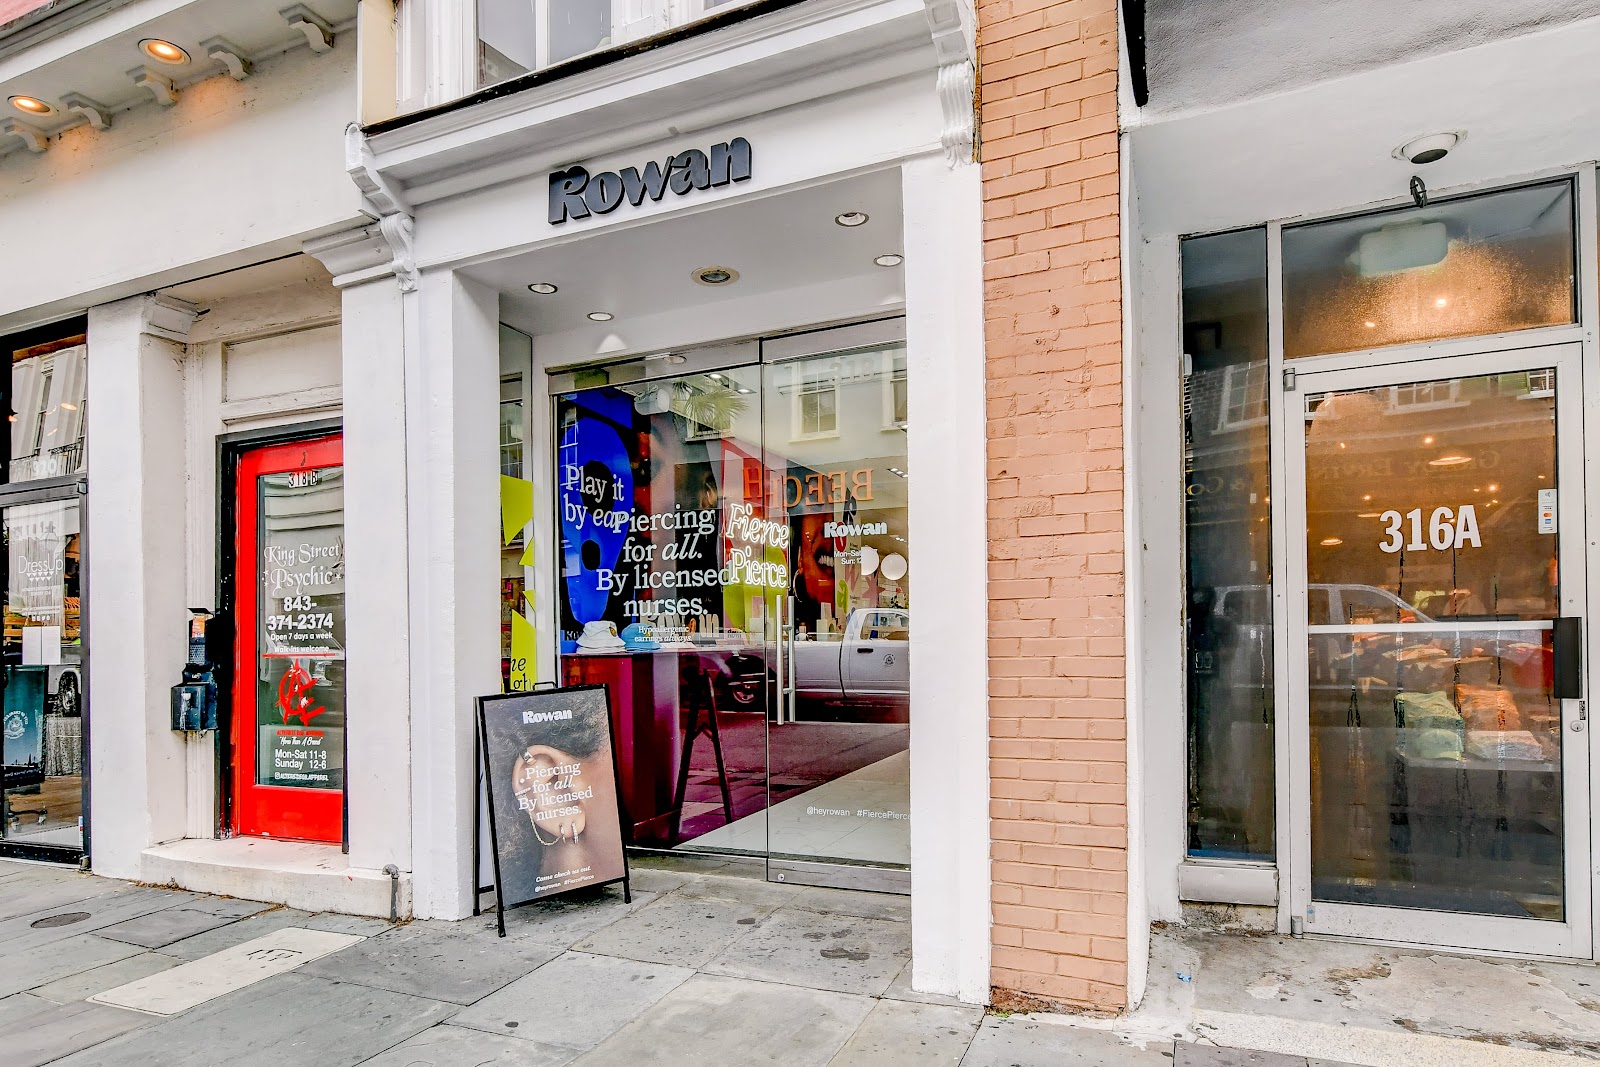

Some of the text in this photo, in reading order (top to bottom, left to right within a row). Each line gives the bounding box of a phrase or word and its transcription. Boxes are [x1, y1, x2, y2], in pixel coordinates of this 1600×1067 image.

[548, 137, 752, 225] Rowan
[566, 465, 624, 503] Play it
[563, 493, 588, 530] by
[613, 503, 716, 535] Piercing
[726, 503, 789, 548] Fierce
[824, 522, 887, 538] Rowan
[1379, 505, 1482, 553] 316A
[264, 543, 339, 567] King Street
[623, 533, 702, 562] for all.
[18, 553, 63, 575] DressUp
[731, 546, 786, 588] Pierce
[270, 565, 333, 596] Psychic
[596, 564, 734, 596] By licensed
[284, 595, 317, 611] 843-
[623, 598, 708, 618] nurses.
[267, 613, 334, 631] 371-2374
[270, 633, 287, 641] Open
[293, 633, 309, 641] days
[315, 631, 333, 639] week
[522, 709, 573, 725] Rowan
[275, 748, 327, 760] Mon-Sat 11-8
[275, 758, 327, 770] Sunday 12-6
[525, 762, 581, 779] Piercing
[532, 775, 576, 794] for all.
[518, 785, 593, 812] By licensed
[536, 805, 582, 821] nurses.
[806, 806, 850, 816] @heyrowan
